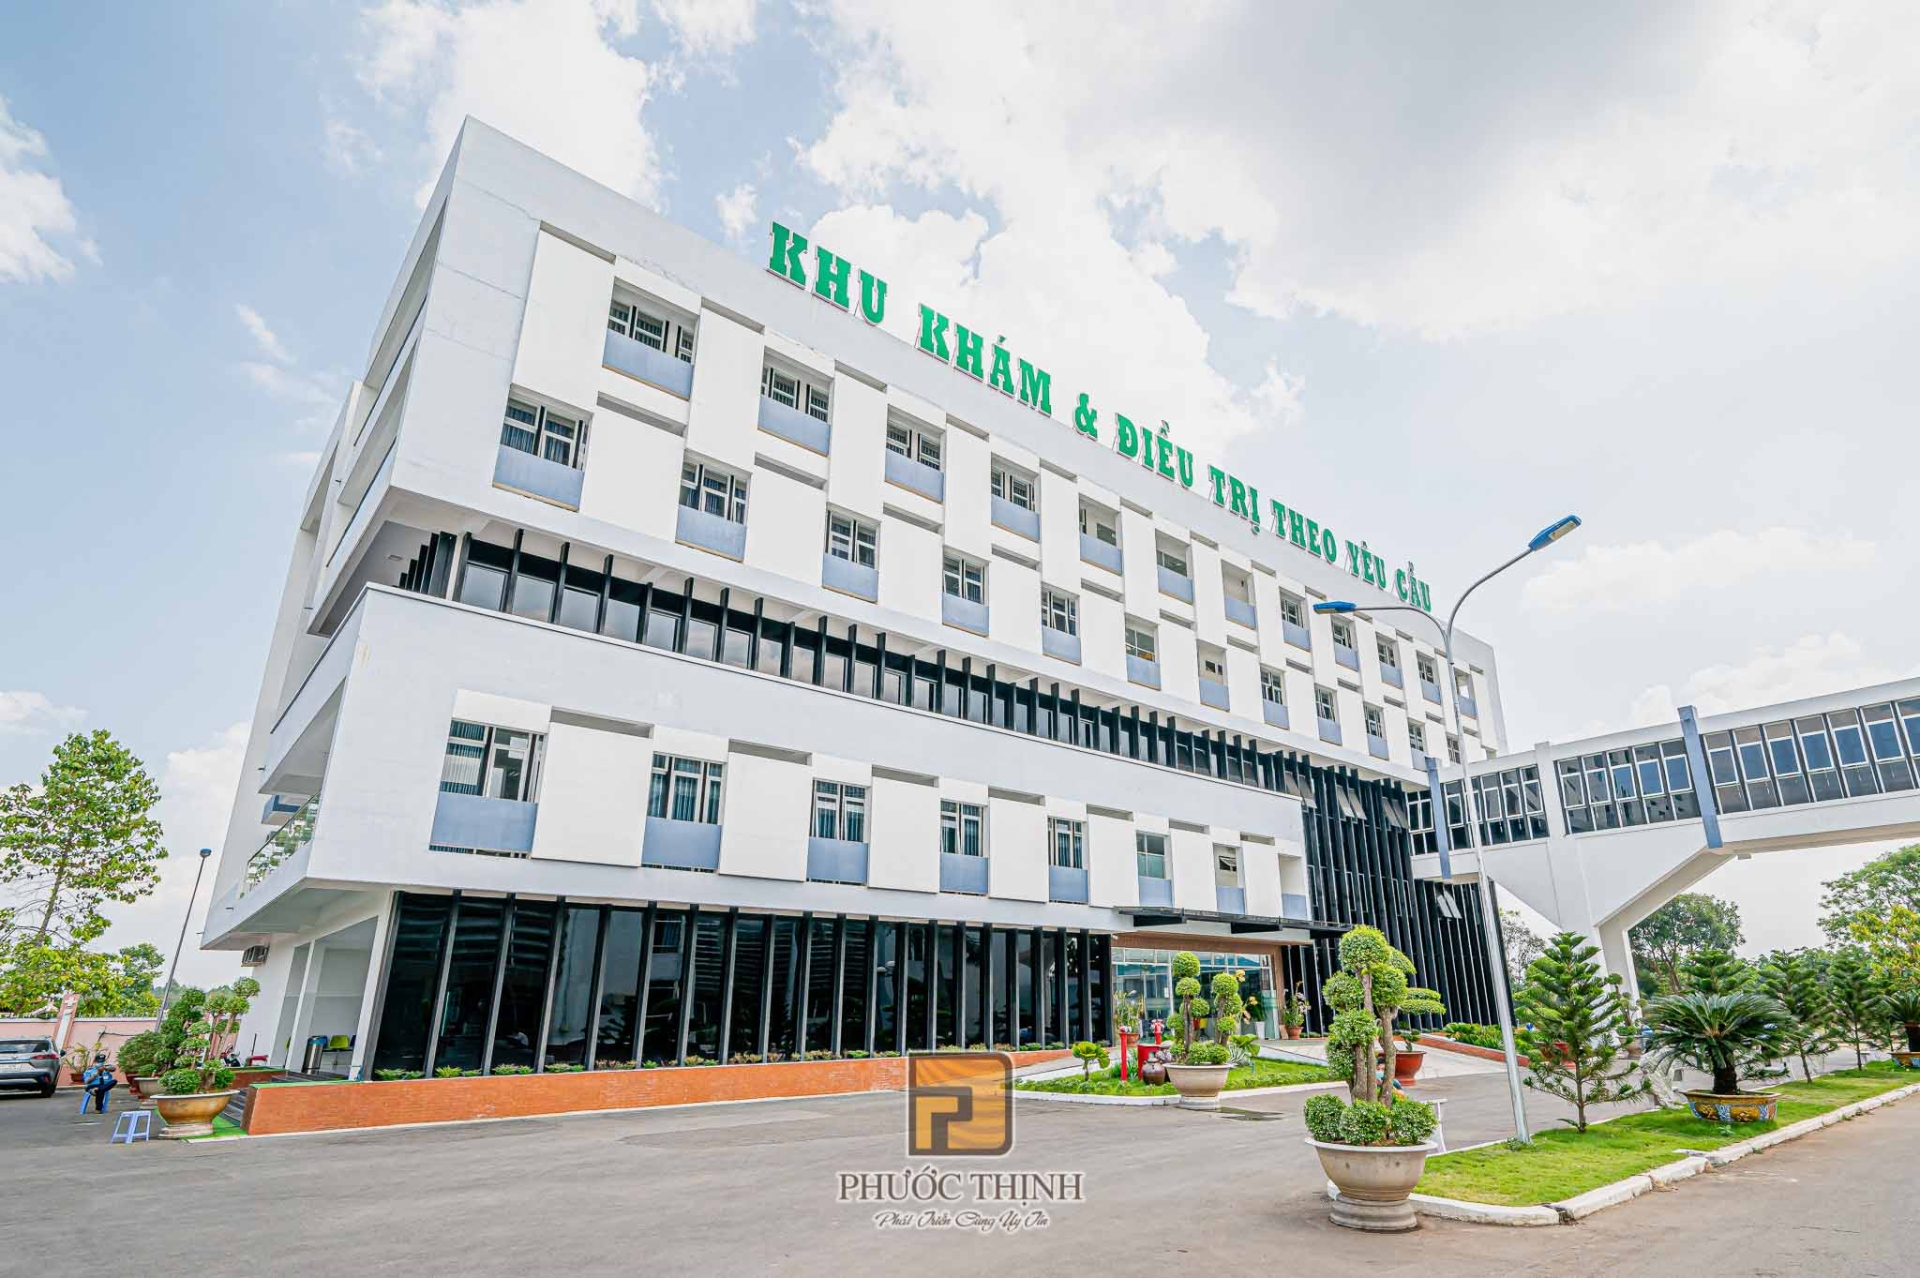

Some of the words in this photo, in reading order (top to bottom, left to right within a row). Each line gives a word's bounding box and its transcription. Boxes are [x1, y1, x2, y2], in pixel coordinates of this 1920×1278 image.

[767, 221, 887, 326] KHU
[916, 303, 1051, 417] KHÁM
[1073, 393, 1098, 440] &
[1114, 413, 1193, 489] ĐIỀU
[1208, 465, 1261, 534] TRỊ
[1270, 499, 1337, 564] THEO
[1345, 540, 1386, 590] YÊU
[1395, 561, 1431, 613] CẦU
